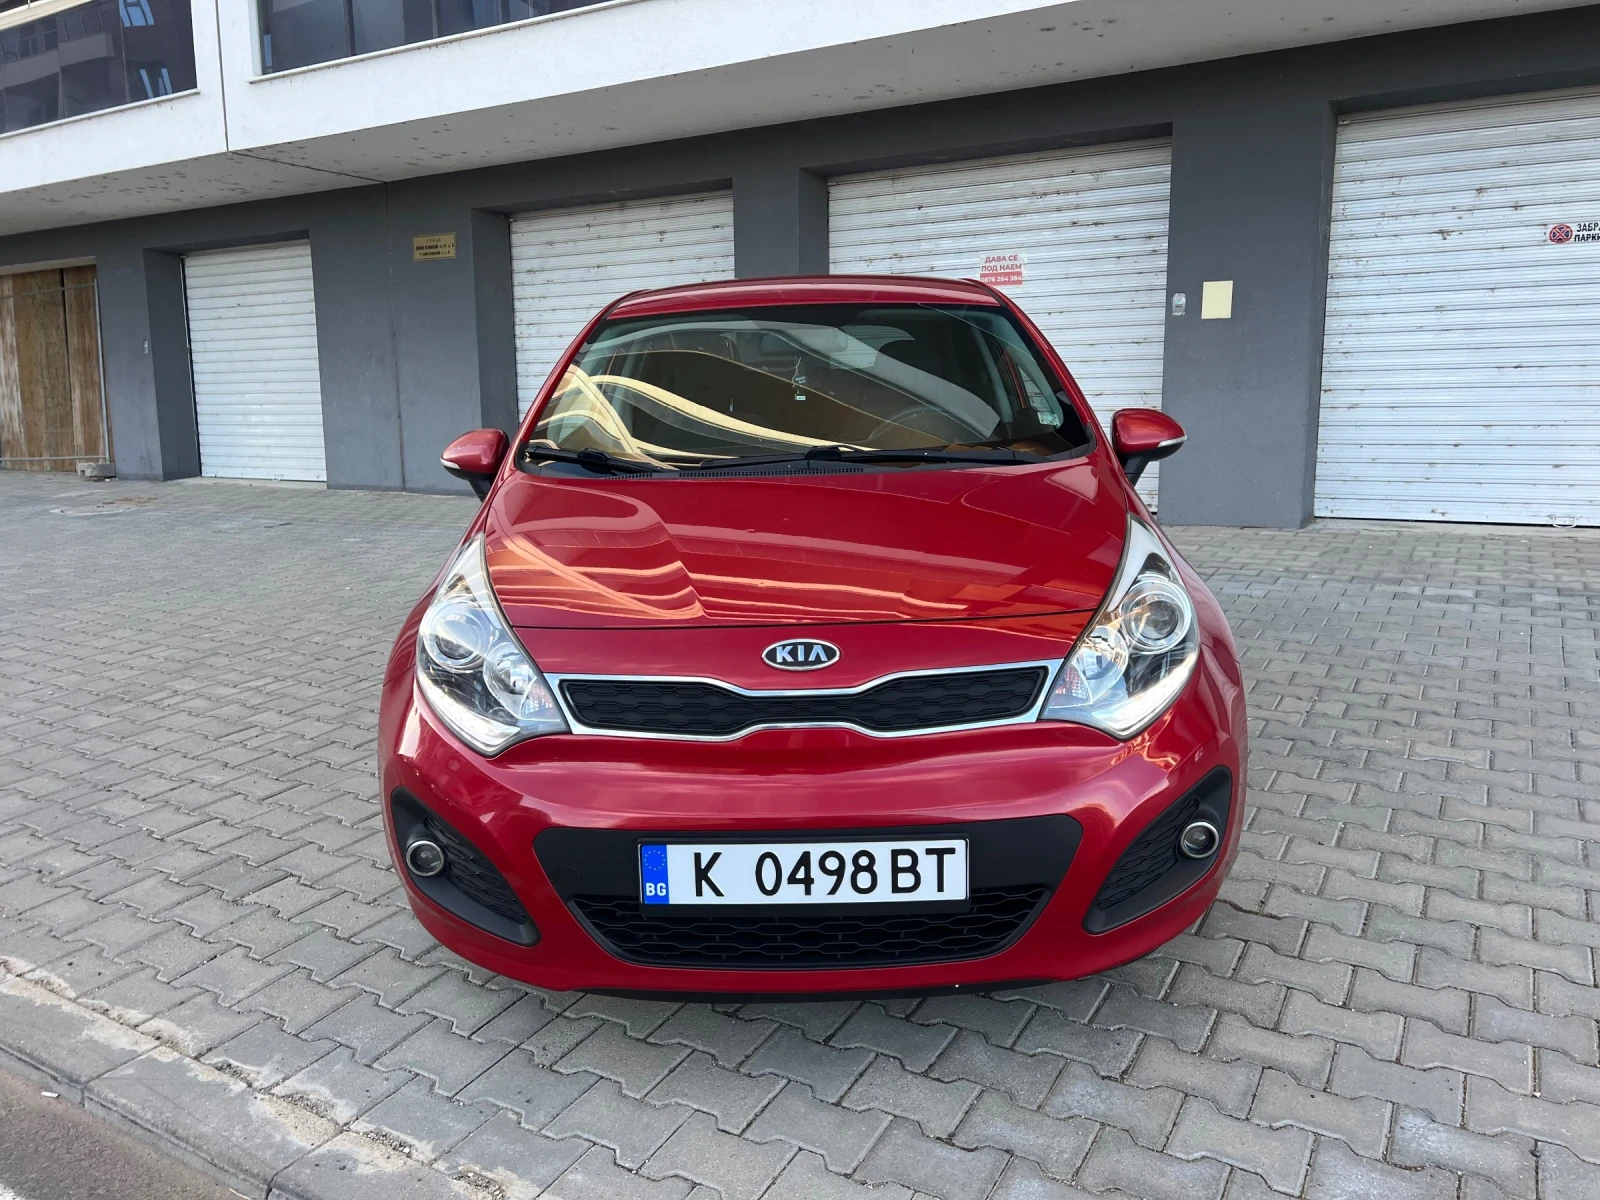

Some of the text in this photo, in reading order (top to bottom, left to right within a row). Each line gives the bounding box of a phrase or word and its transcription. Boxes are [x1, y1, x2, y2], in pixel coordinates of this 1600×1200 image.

[1577, 222, 1600, 232] ЗАБР
[985, 256, 1007, 264] ДАВА
[776, 645, 828, 662] KIA
[693, 852, 724, 897] K
[645, 883, 667, 896] BG
